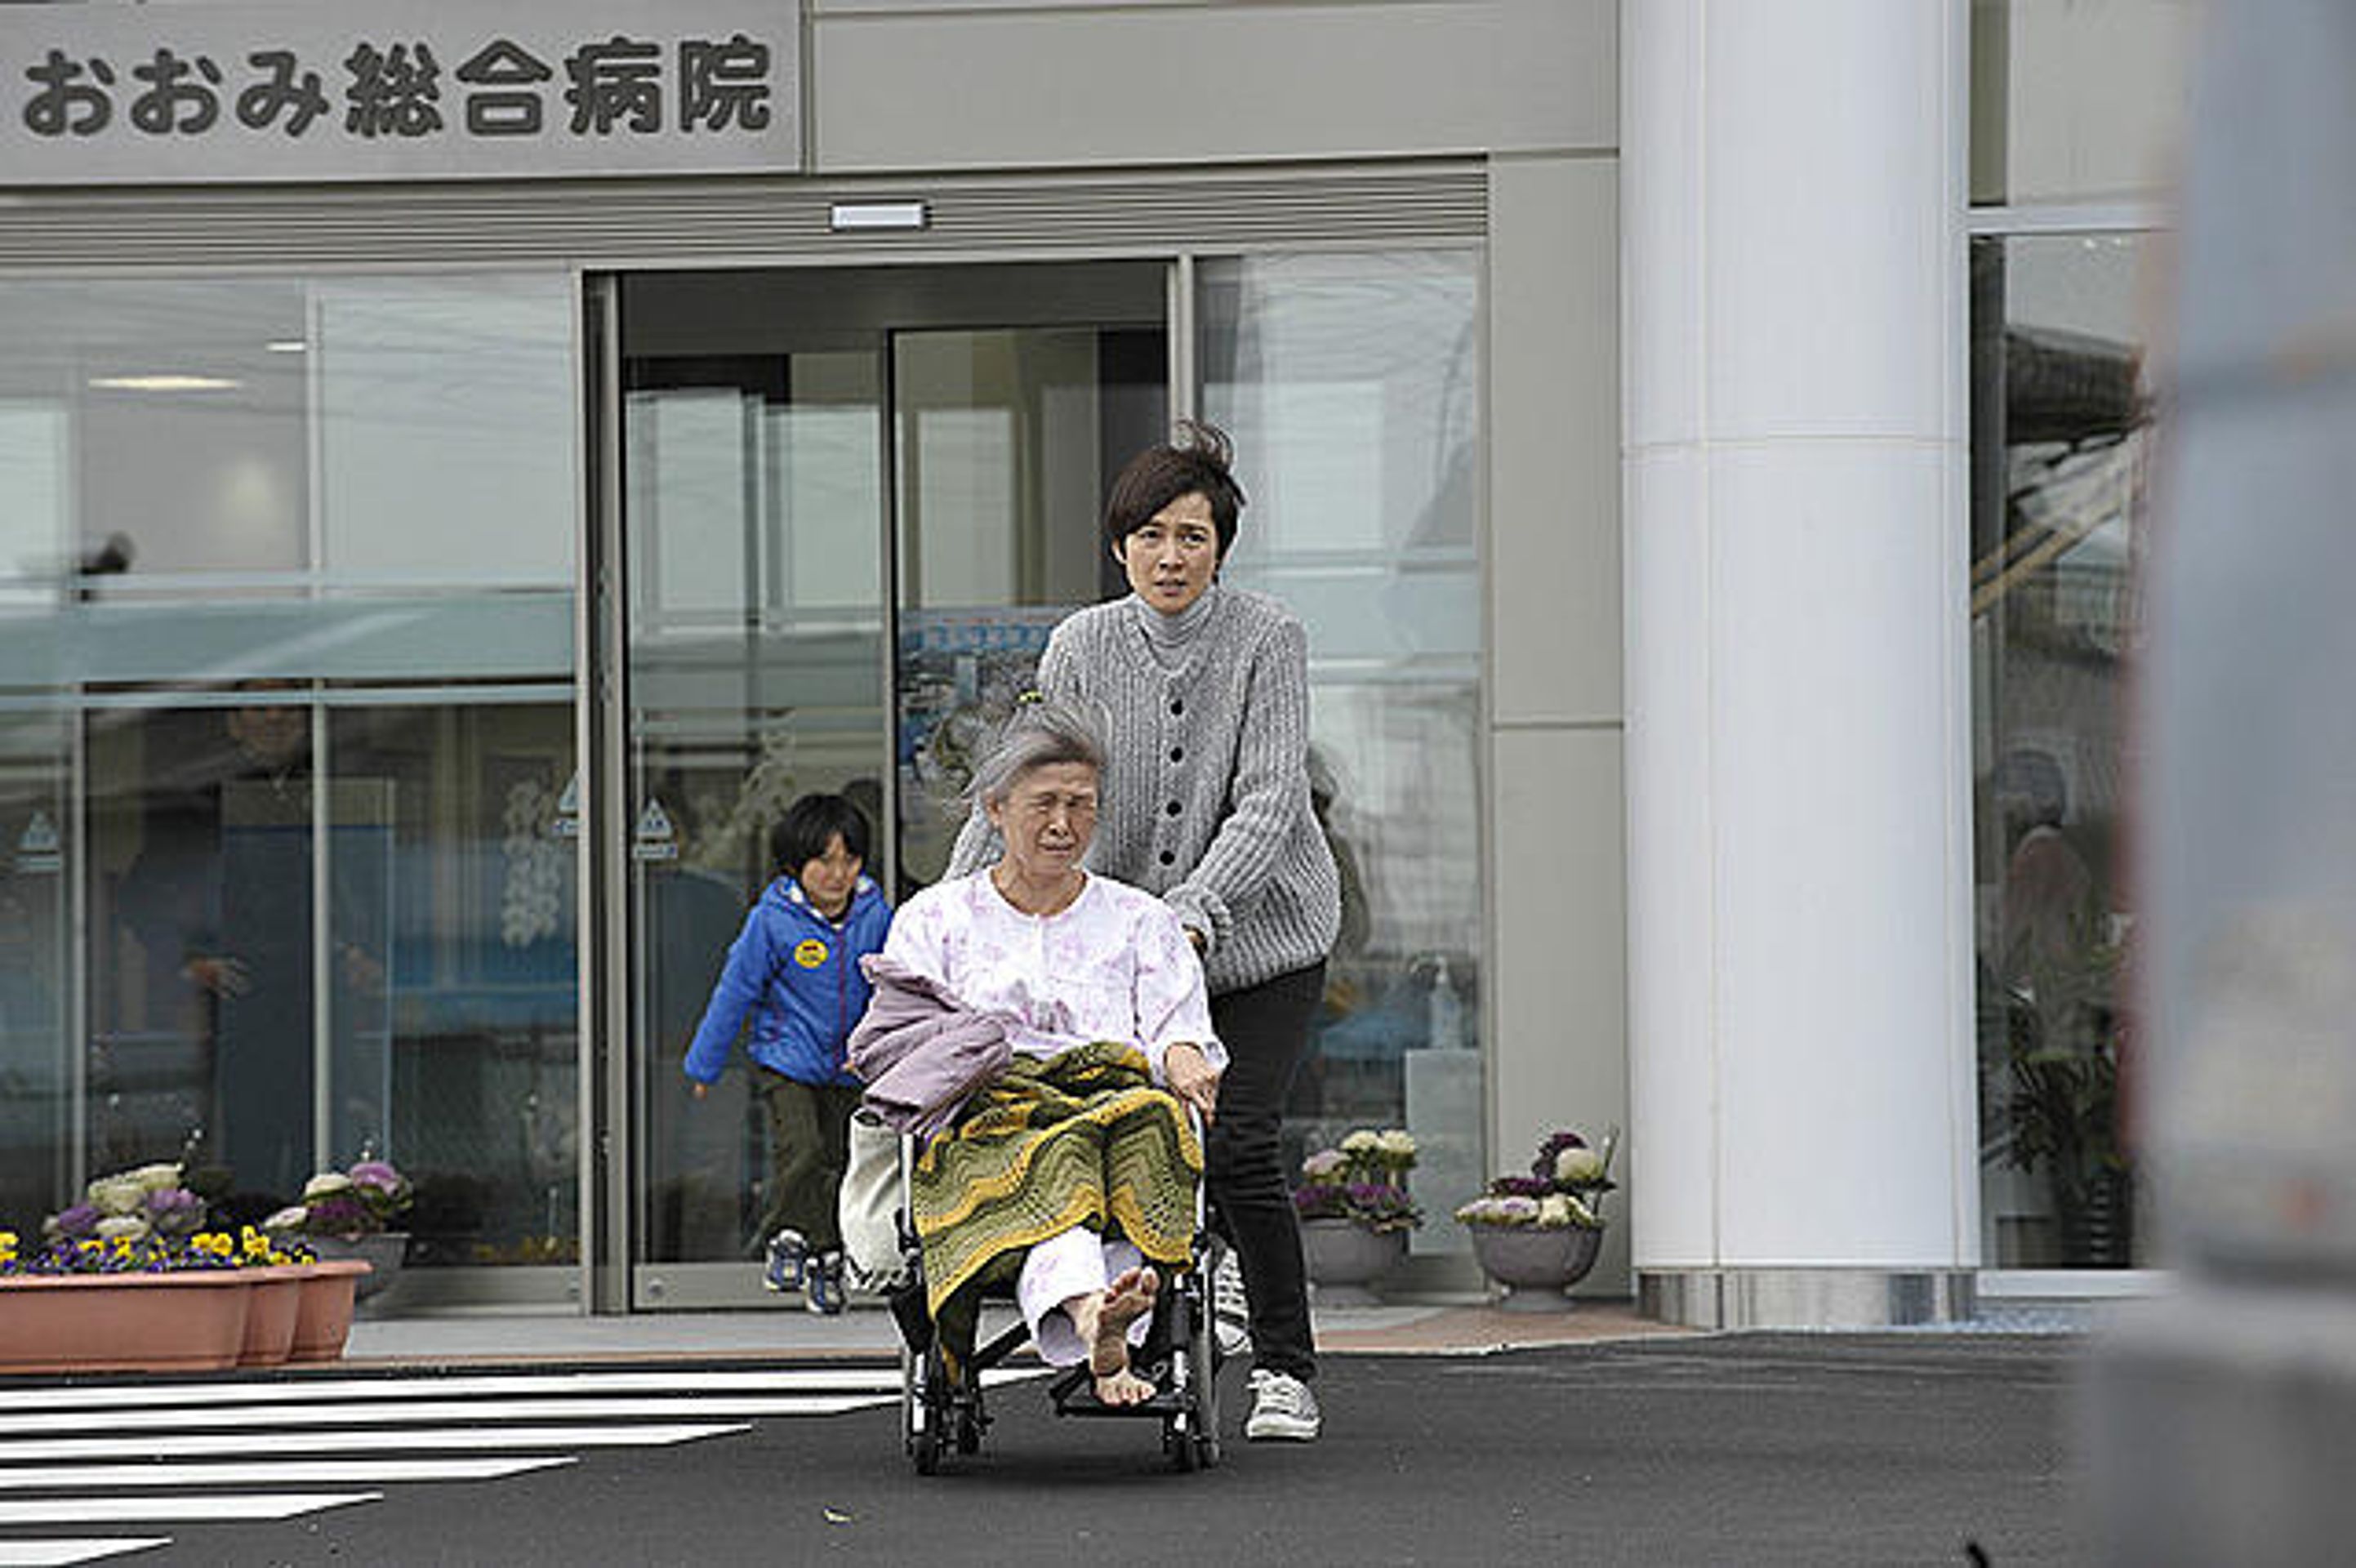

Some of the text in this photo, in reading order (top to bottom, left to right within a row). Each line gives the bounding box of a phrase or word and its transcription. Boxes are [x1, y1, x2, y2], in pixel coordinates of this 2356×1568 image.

[21, 33, 772, 139] おおみ総合病院
